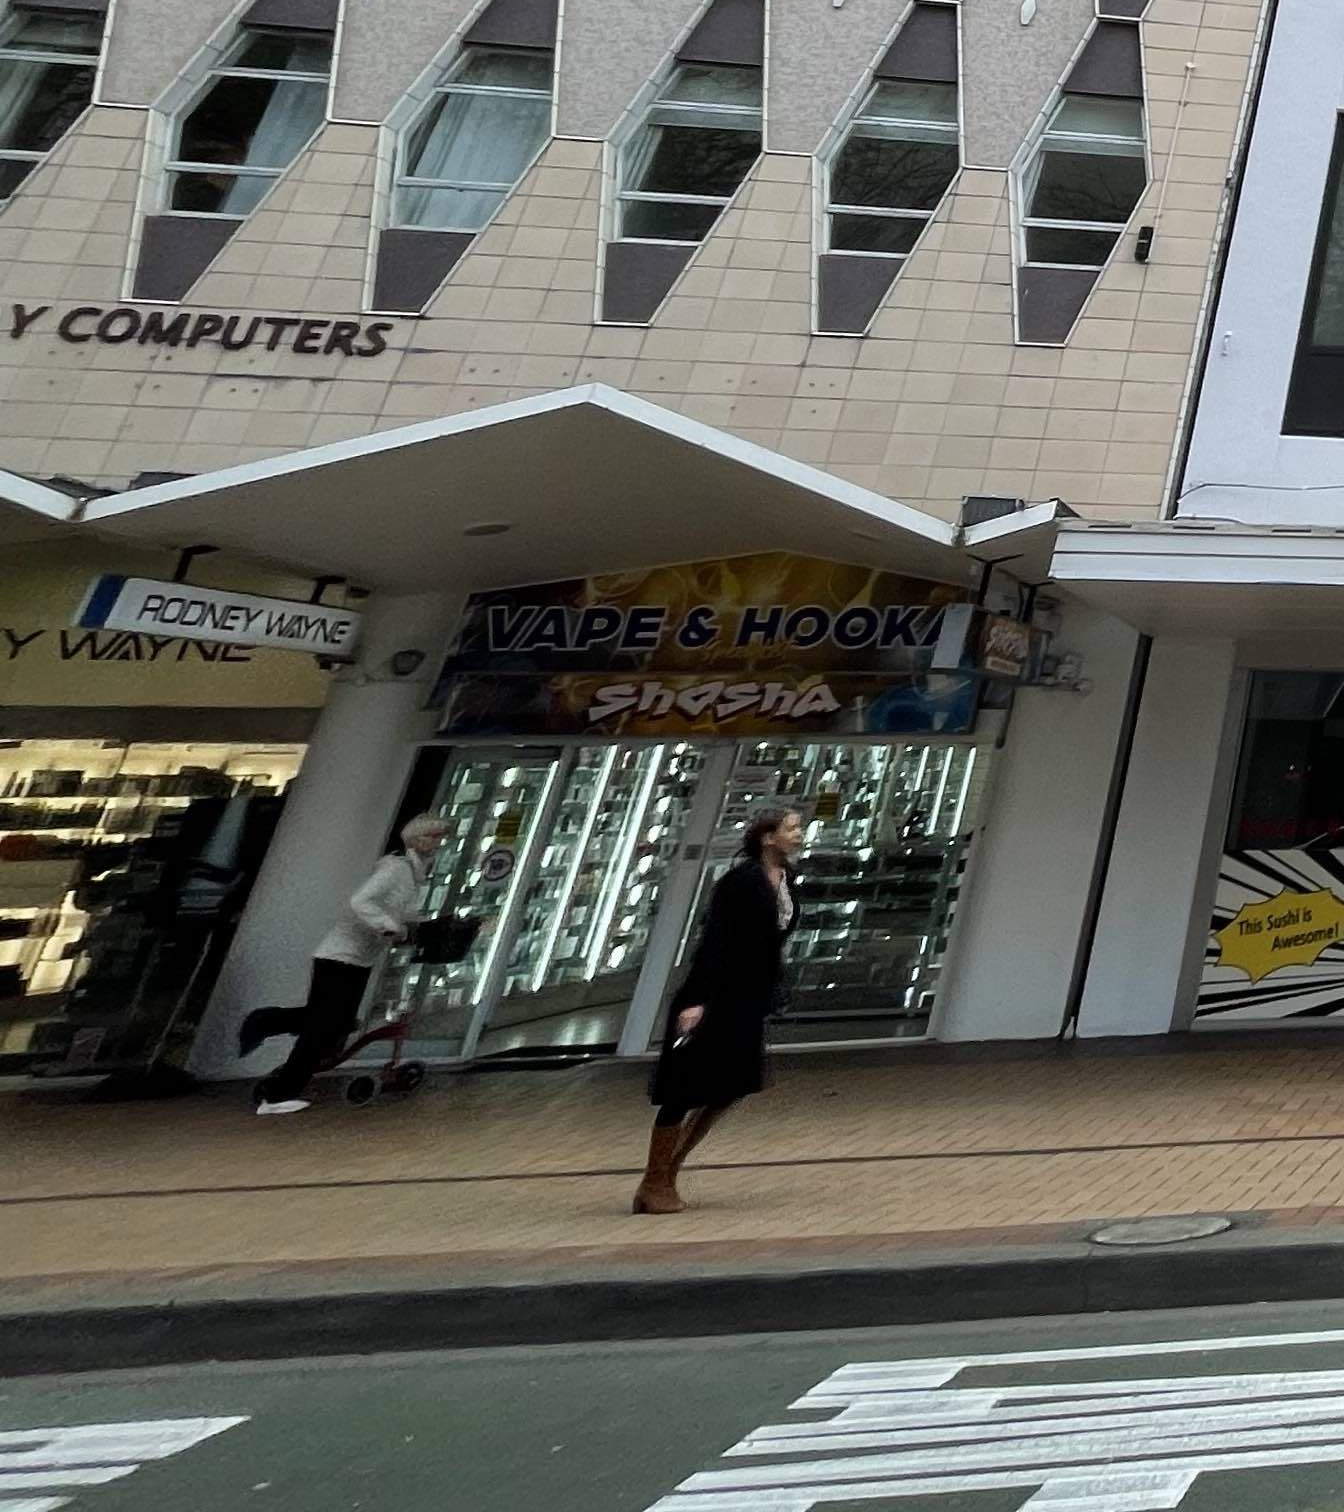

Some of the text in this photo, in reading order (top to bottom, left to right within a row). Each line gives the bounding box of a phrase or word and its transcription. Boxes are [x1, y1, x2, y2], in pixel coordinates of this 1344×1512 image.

[10, 303, 394, 357] Y COMPUTERS
[137, 594, 352, 644] RODNEY WAYNE
[488, 604, 668, 652] VAPE
[677, 605, 720, 650] &
[1238, 907, 1313, 937] This Sushi is
[1271, 922, 1340, 952] Awesome!
